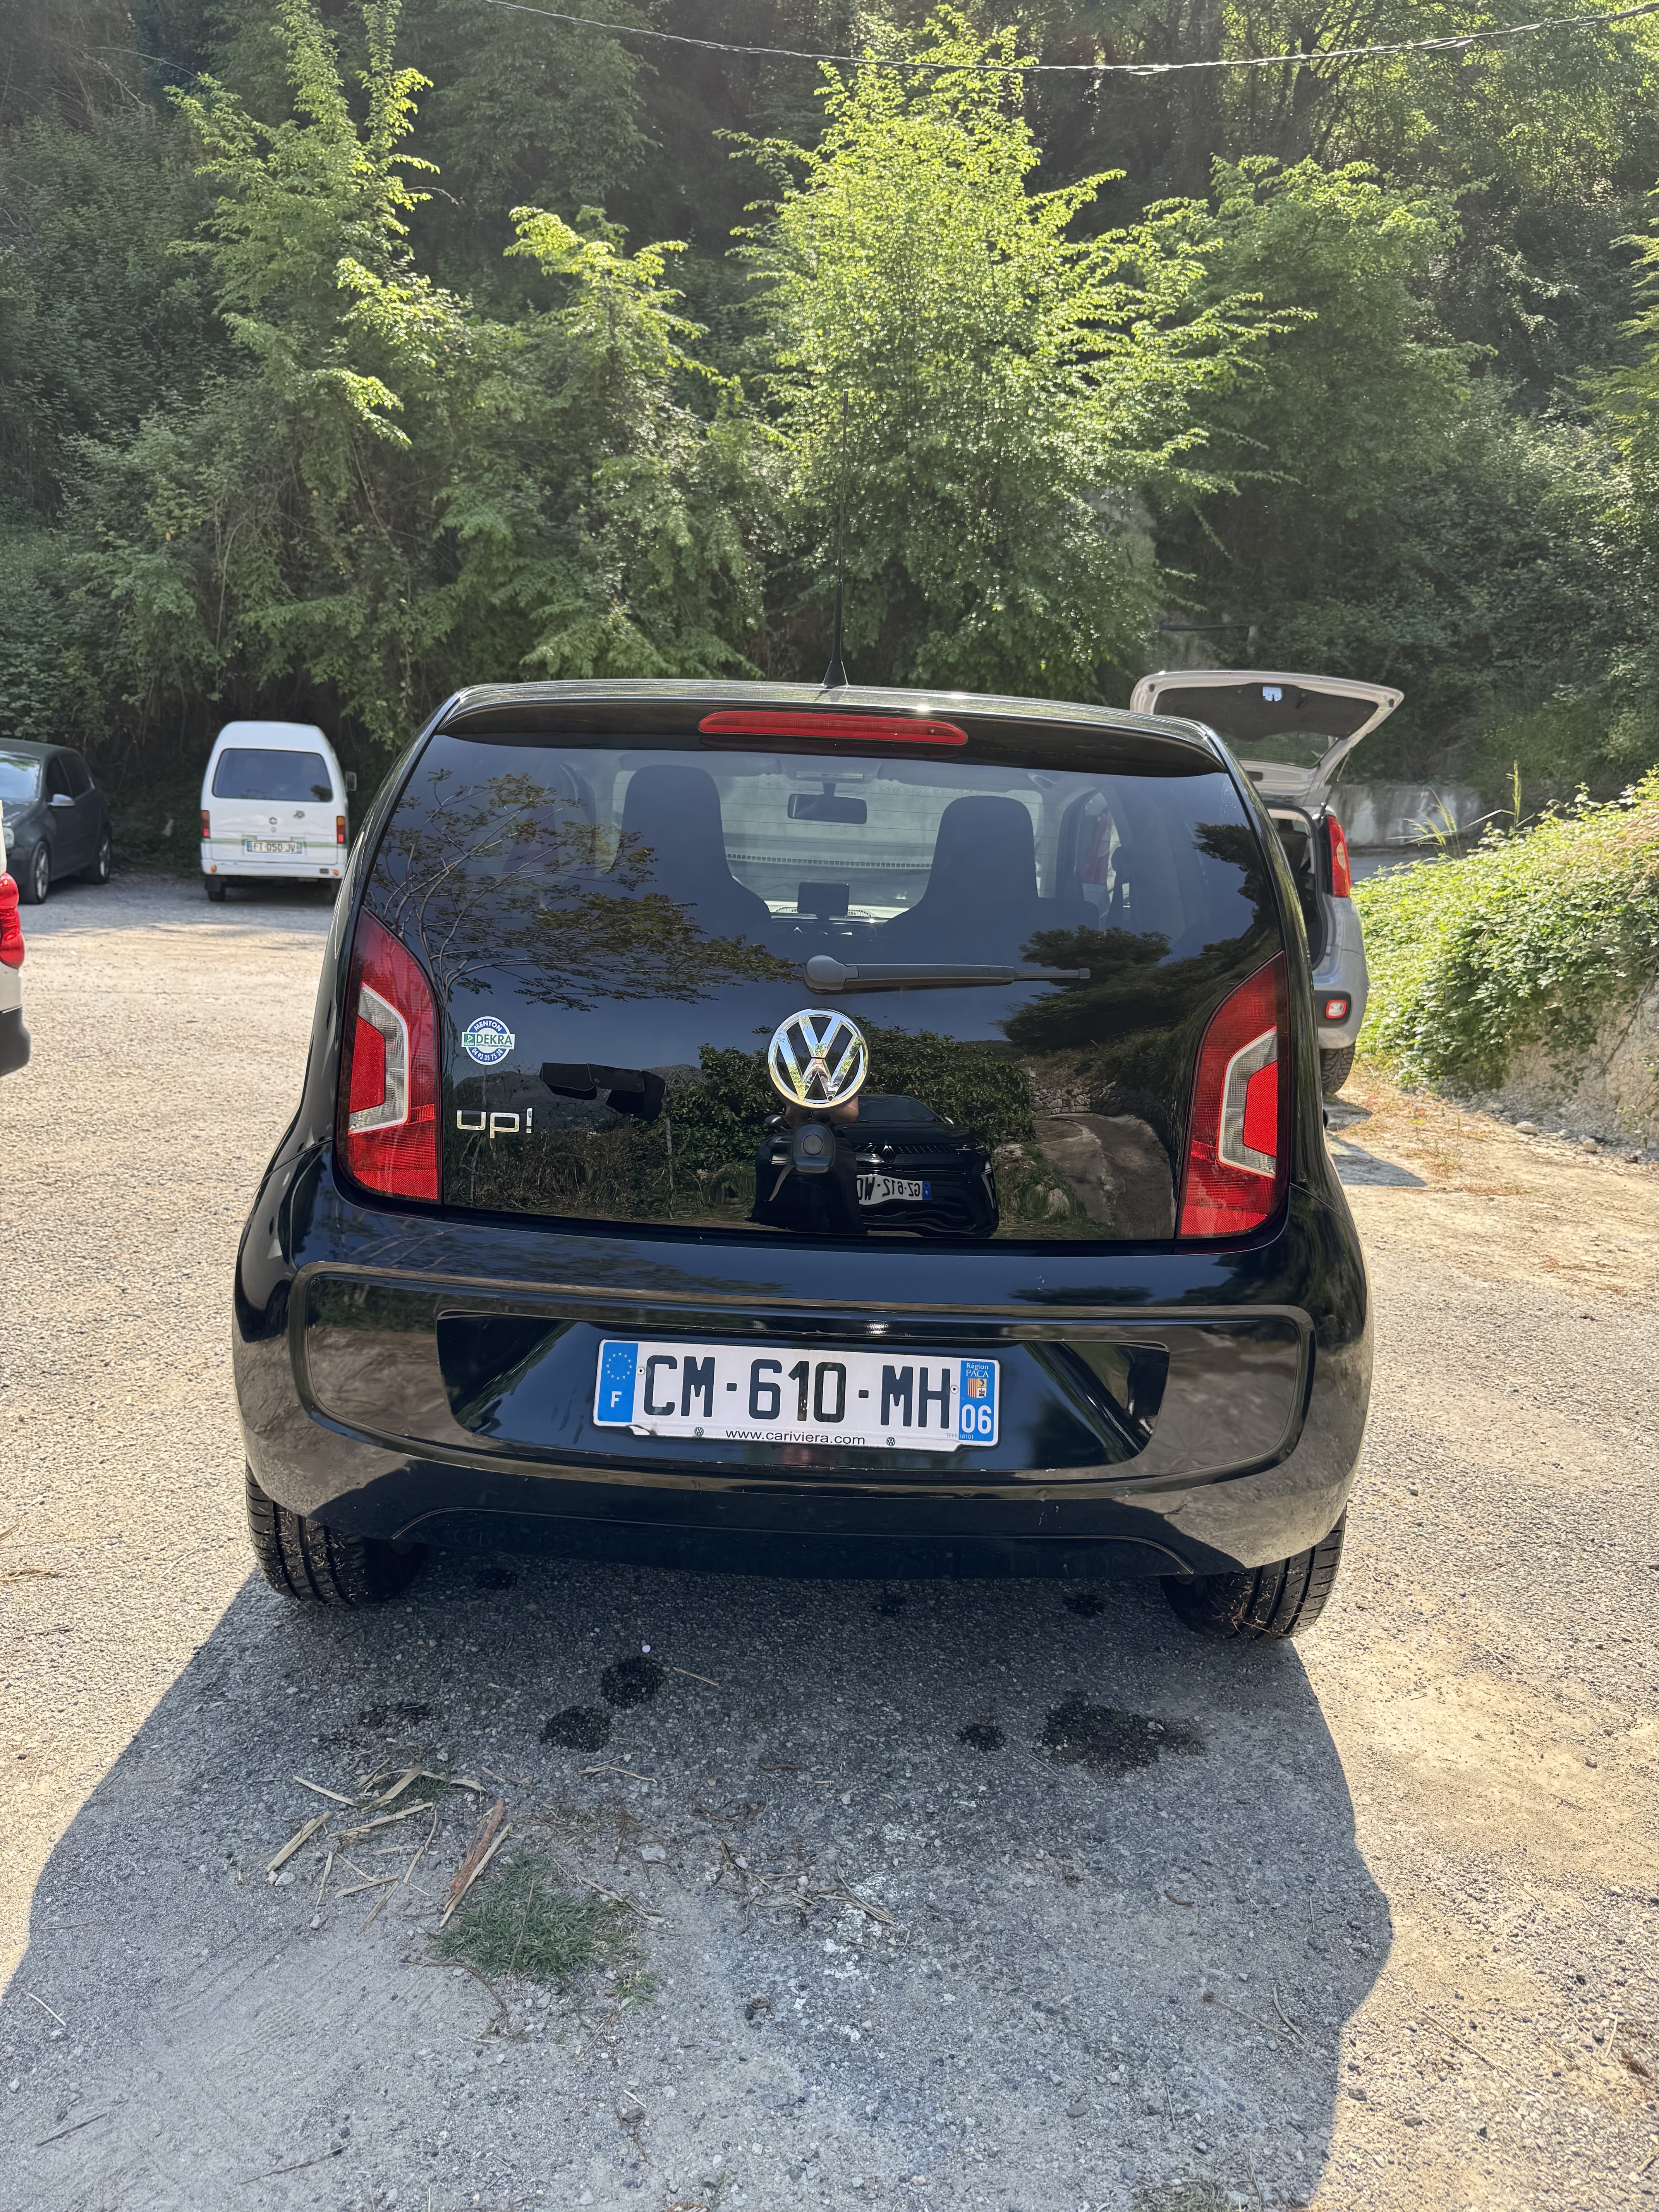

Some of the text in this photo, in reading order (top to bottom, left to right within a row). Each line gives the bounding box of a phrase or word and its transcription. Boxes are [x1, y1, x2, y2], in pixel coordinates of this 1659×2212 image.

[474, 1020, 502, 1032] MENTON
[476, 1034, 512, 1045] DEKRA
[768, 1008, 868, 1108] VW
[457, 1108, 533, 1139] up!
[966, 1369, 989, 1378] PACA
[610, 1391, 622, 1408] F
[644, 1355, 951, 1429] CM-610-MH
[962, 1404, 992, 1434] 06
[726, 1430, 865, 1445] www.cariviera.com
